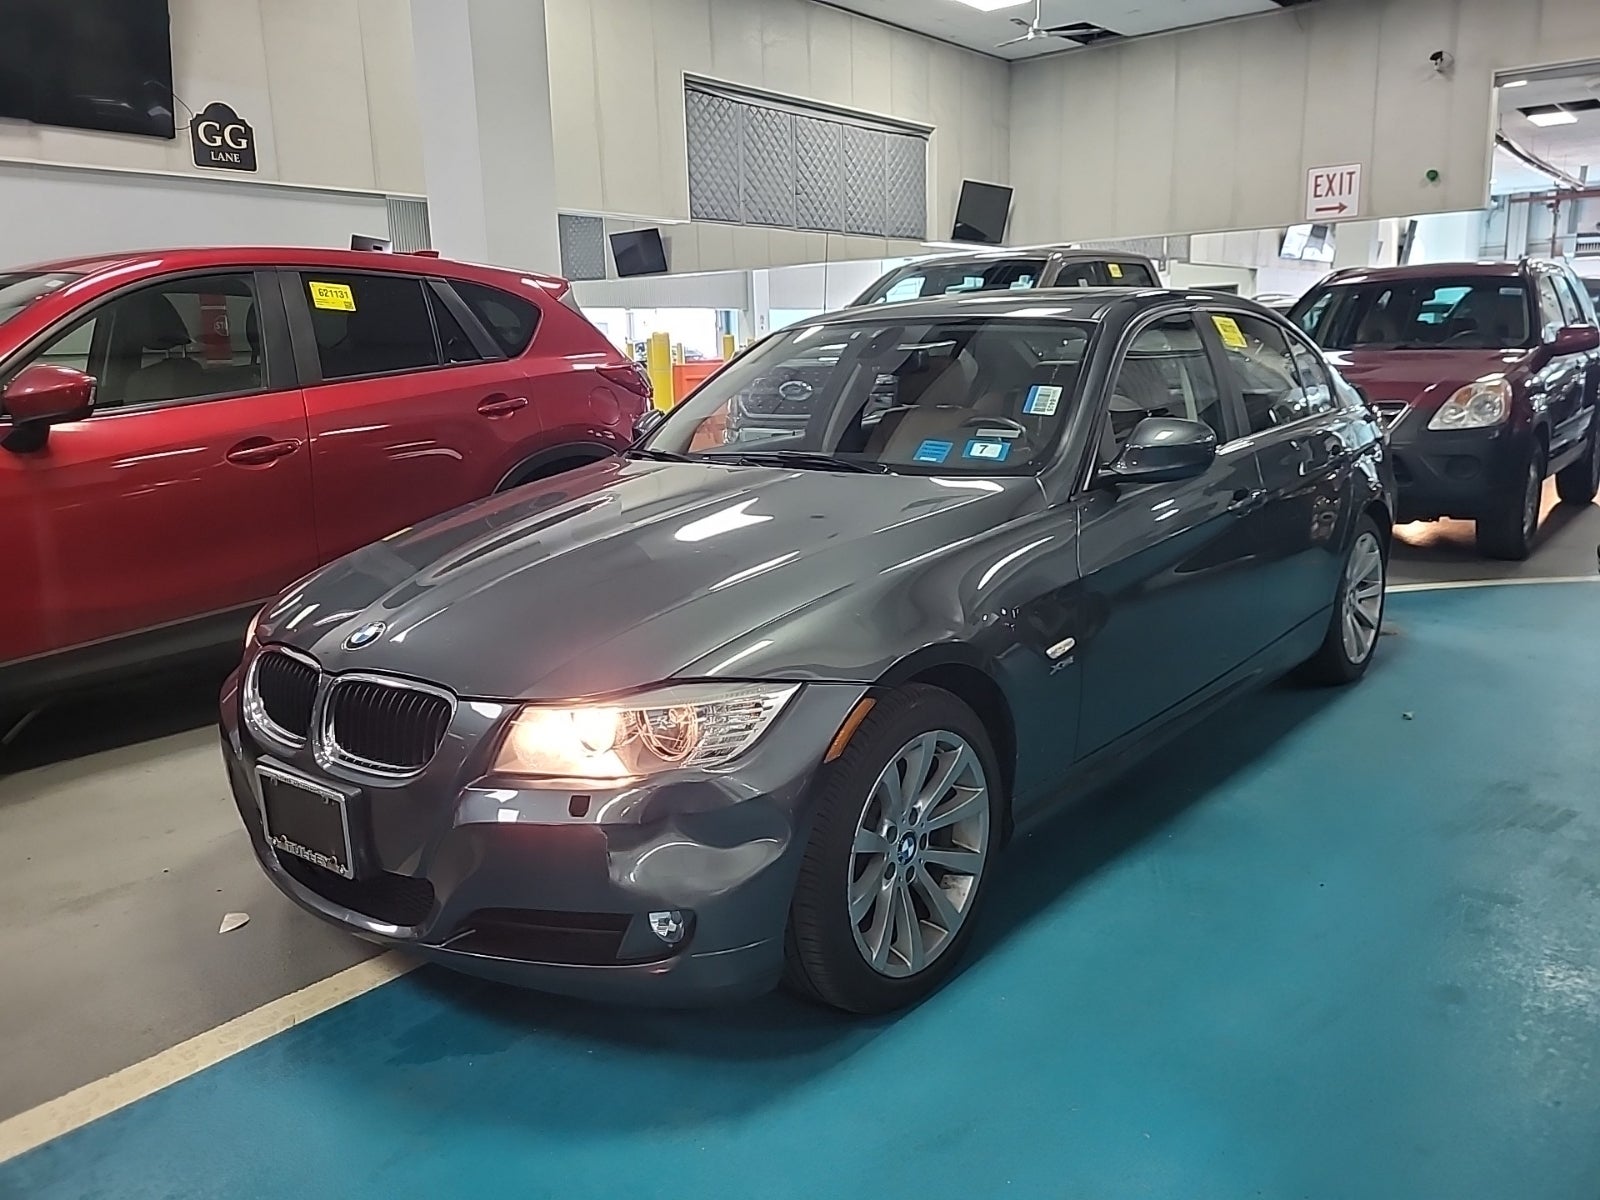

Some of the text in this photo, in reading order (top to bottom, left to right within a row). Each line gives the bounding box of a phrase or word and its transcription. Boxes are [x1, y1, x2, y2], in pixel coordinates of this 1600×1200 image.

[198, 121, 248, 150] GG
[210, 151, 241, 163] LANE
[1313, 171, 1356, 198] EXIT
[318, 288, 349, 299] 621131
[980, 444, 989, 454] 7
